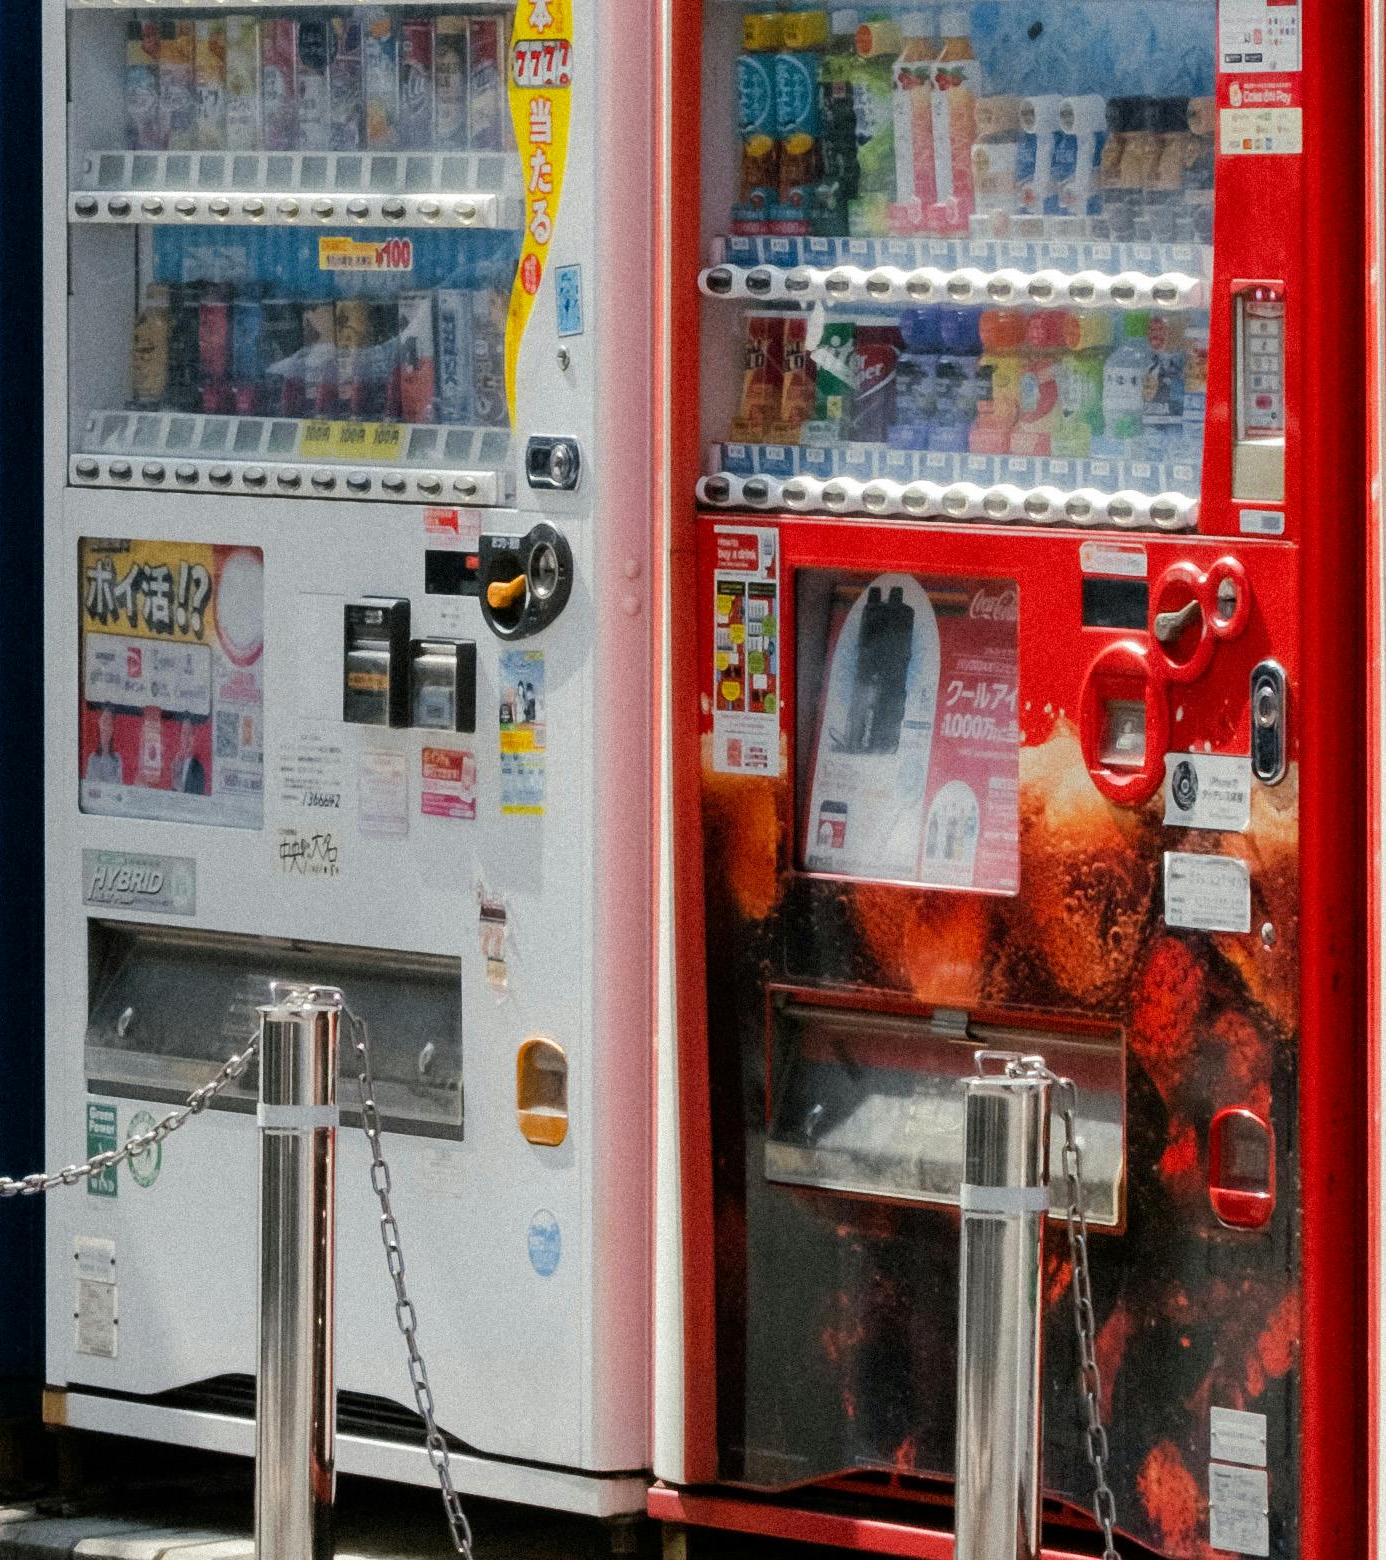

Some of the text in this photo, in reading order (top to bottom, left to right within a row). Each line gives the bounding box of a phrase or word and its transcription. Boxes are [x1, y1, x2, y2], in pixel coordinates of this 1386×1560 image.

[529, 95, 552, 245] 当たる
[92, 865, 164, 895] HYBRID
